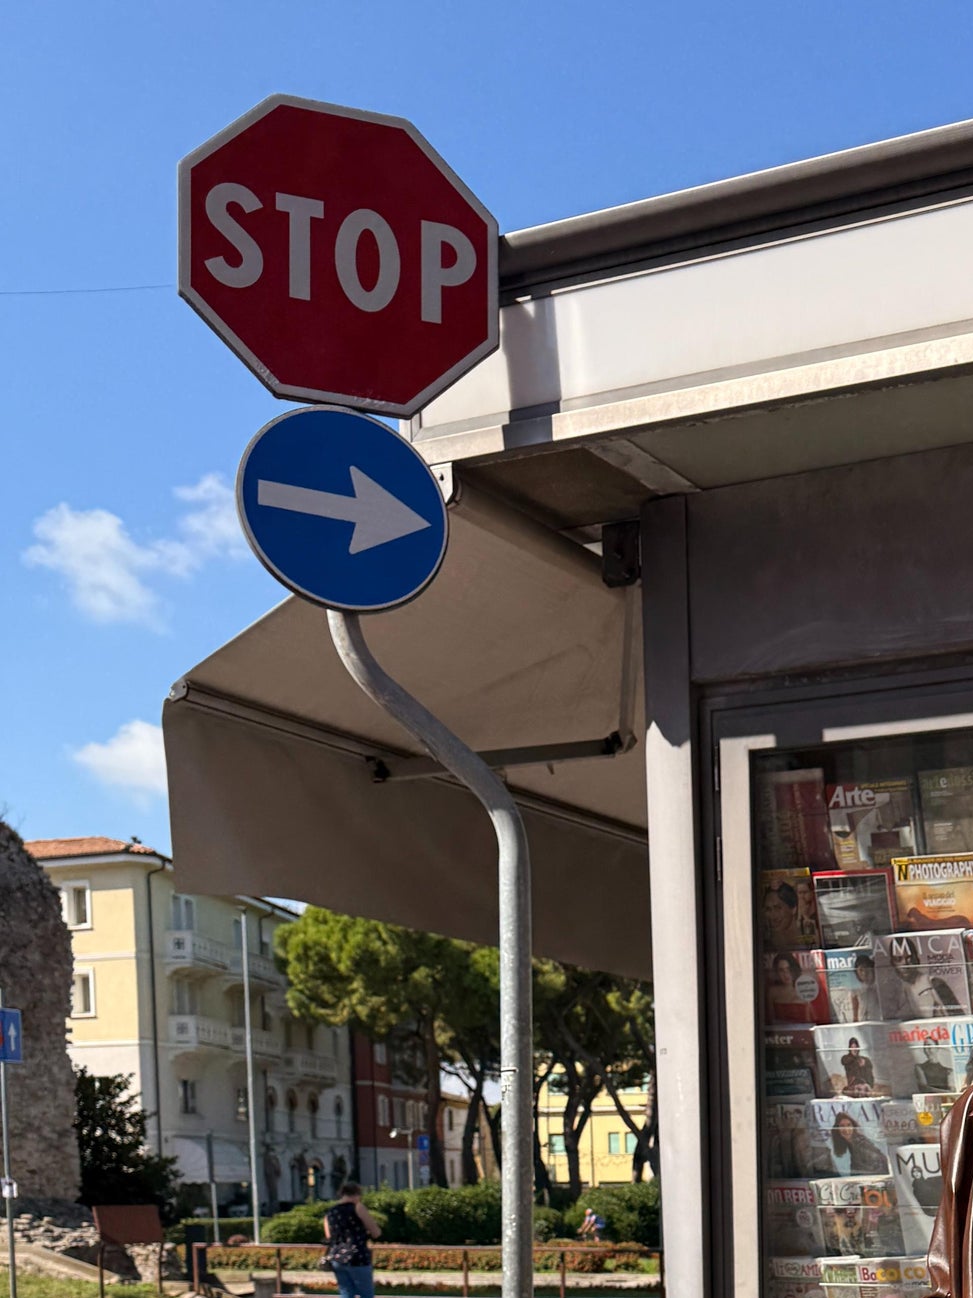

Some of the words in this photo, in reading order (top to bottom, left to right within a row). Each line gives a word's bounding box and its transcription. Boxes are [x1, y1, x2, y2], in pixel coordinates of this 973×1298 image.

[204, 182, 477, 324] STOP
[828, 785, 876, 808] Arte
[872, 935, 960, 958] AMICA
